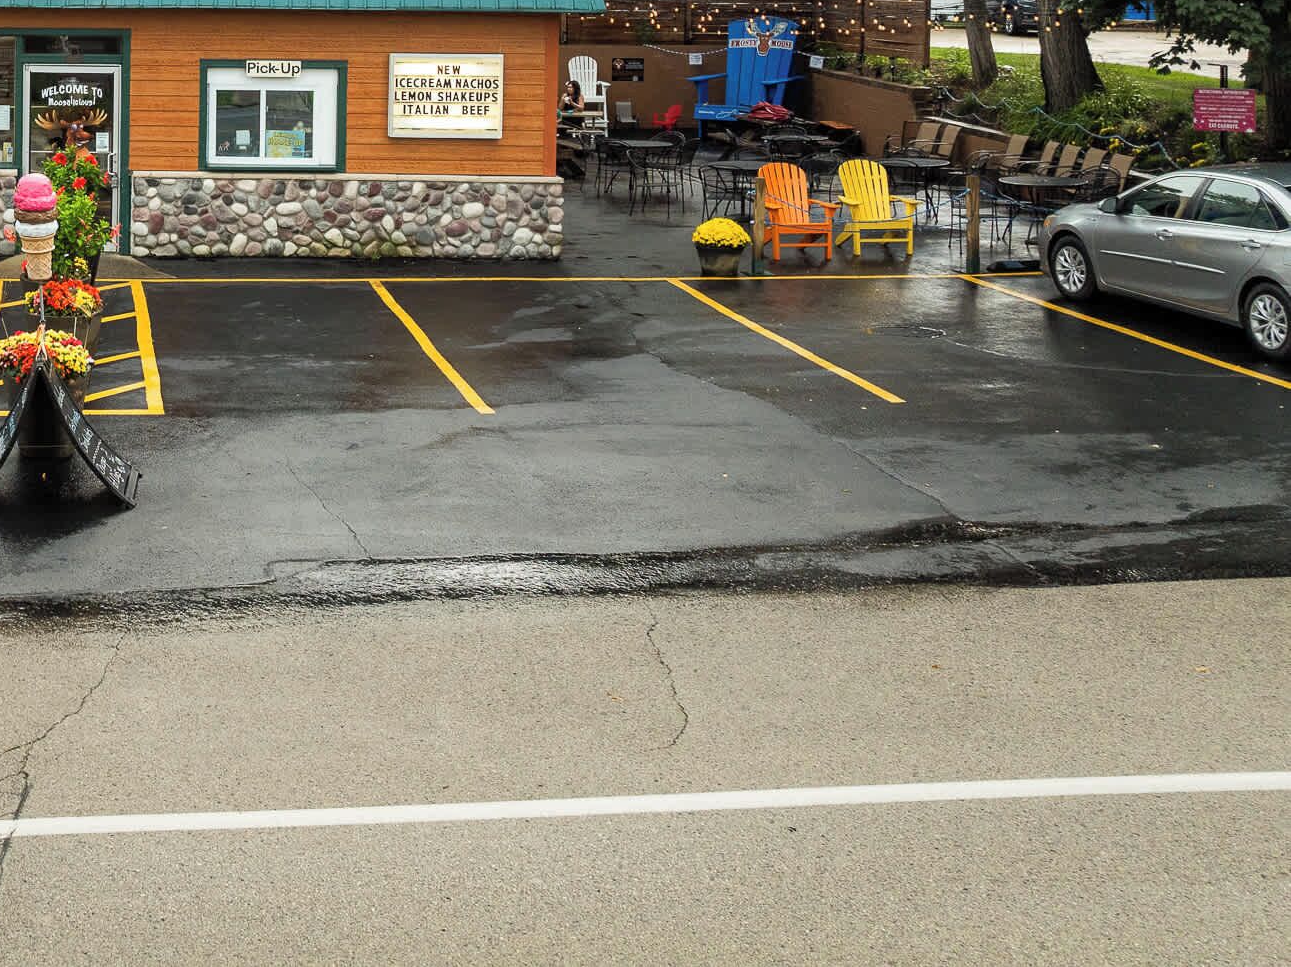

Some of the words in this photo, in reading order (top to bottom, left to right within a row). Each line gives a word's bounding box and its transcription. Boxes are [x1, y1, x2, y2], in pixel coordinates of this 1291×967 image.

[247, 62, 301, 76] Pick-Up
[437, 65, 461, 75] NEW
[395, 78, 452, 89] ICECREAM
[455, 79, 499, 89] NACHOS
[41, 84, 89, 99] WELCOME
[91, 87, 103, 99] TO
[394, 91, 432, 101] LEMON
[437, 92, 498, 102] SHAKEUPS
[403, 104, 449, 115] ITALIAN
[462, 105, 490, 115] BEEF
